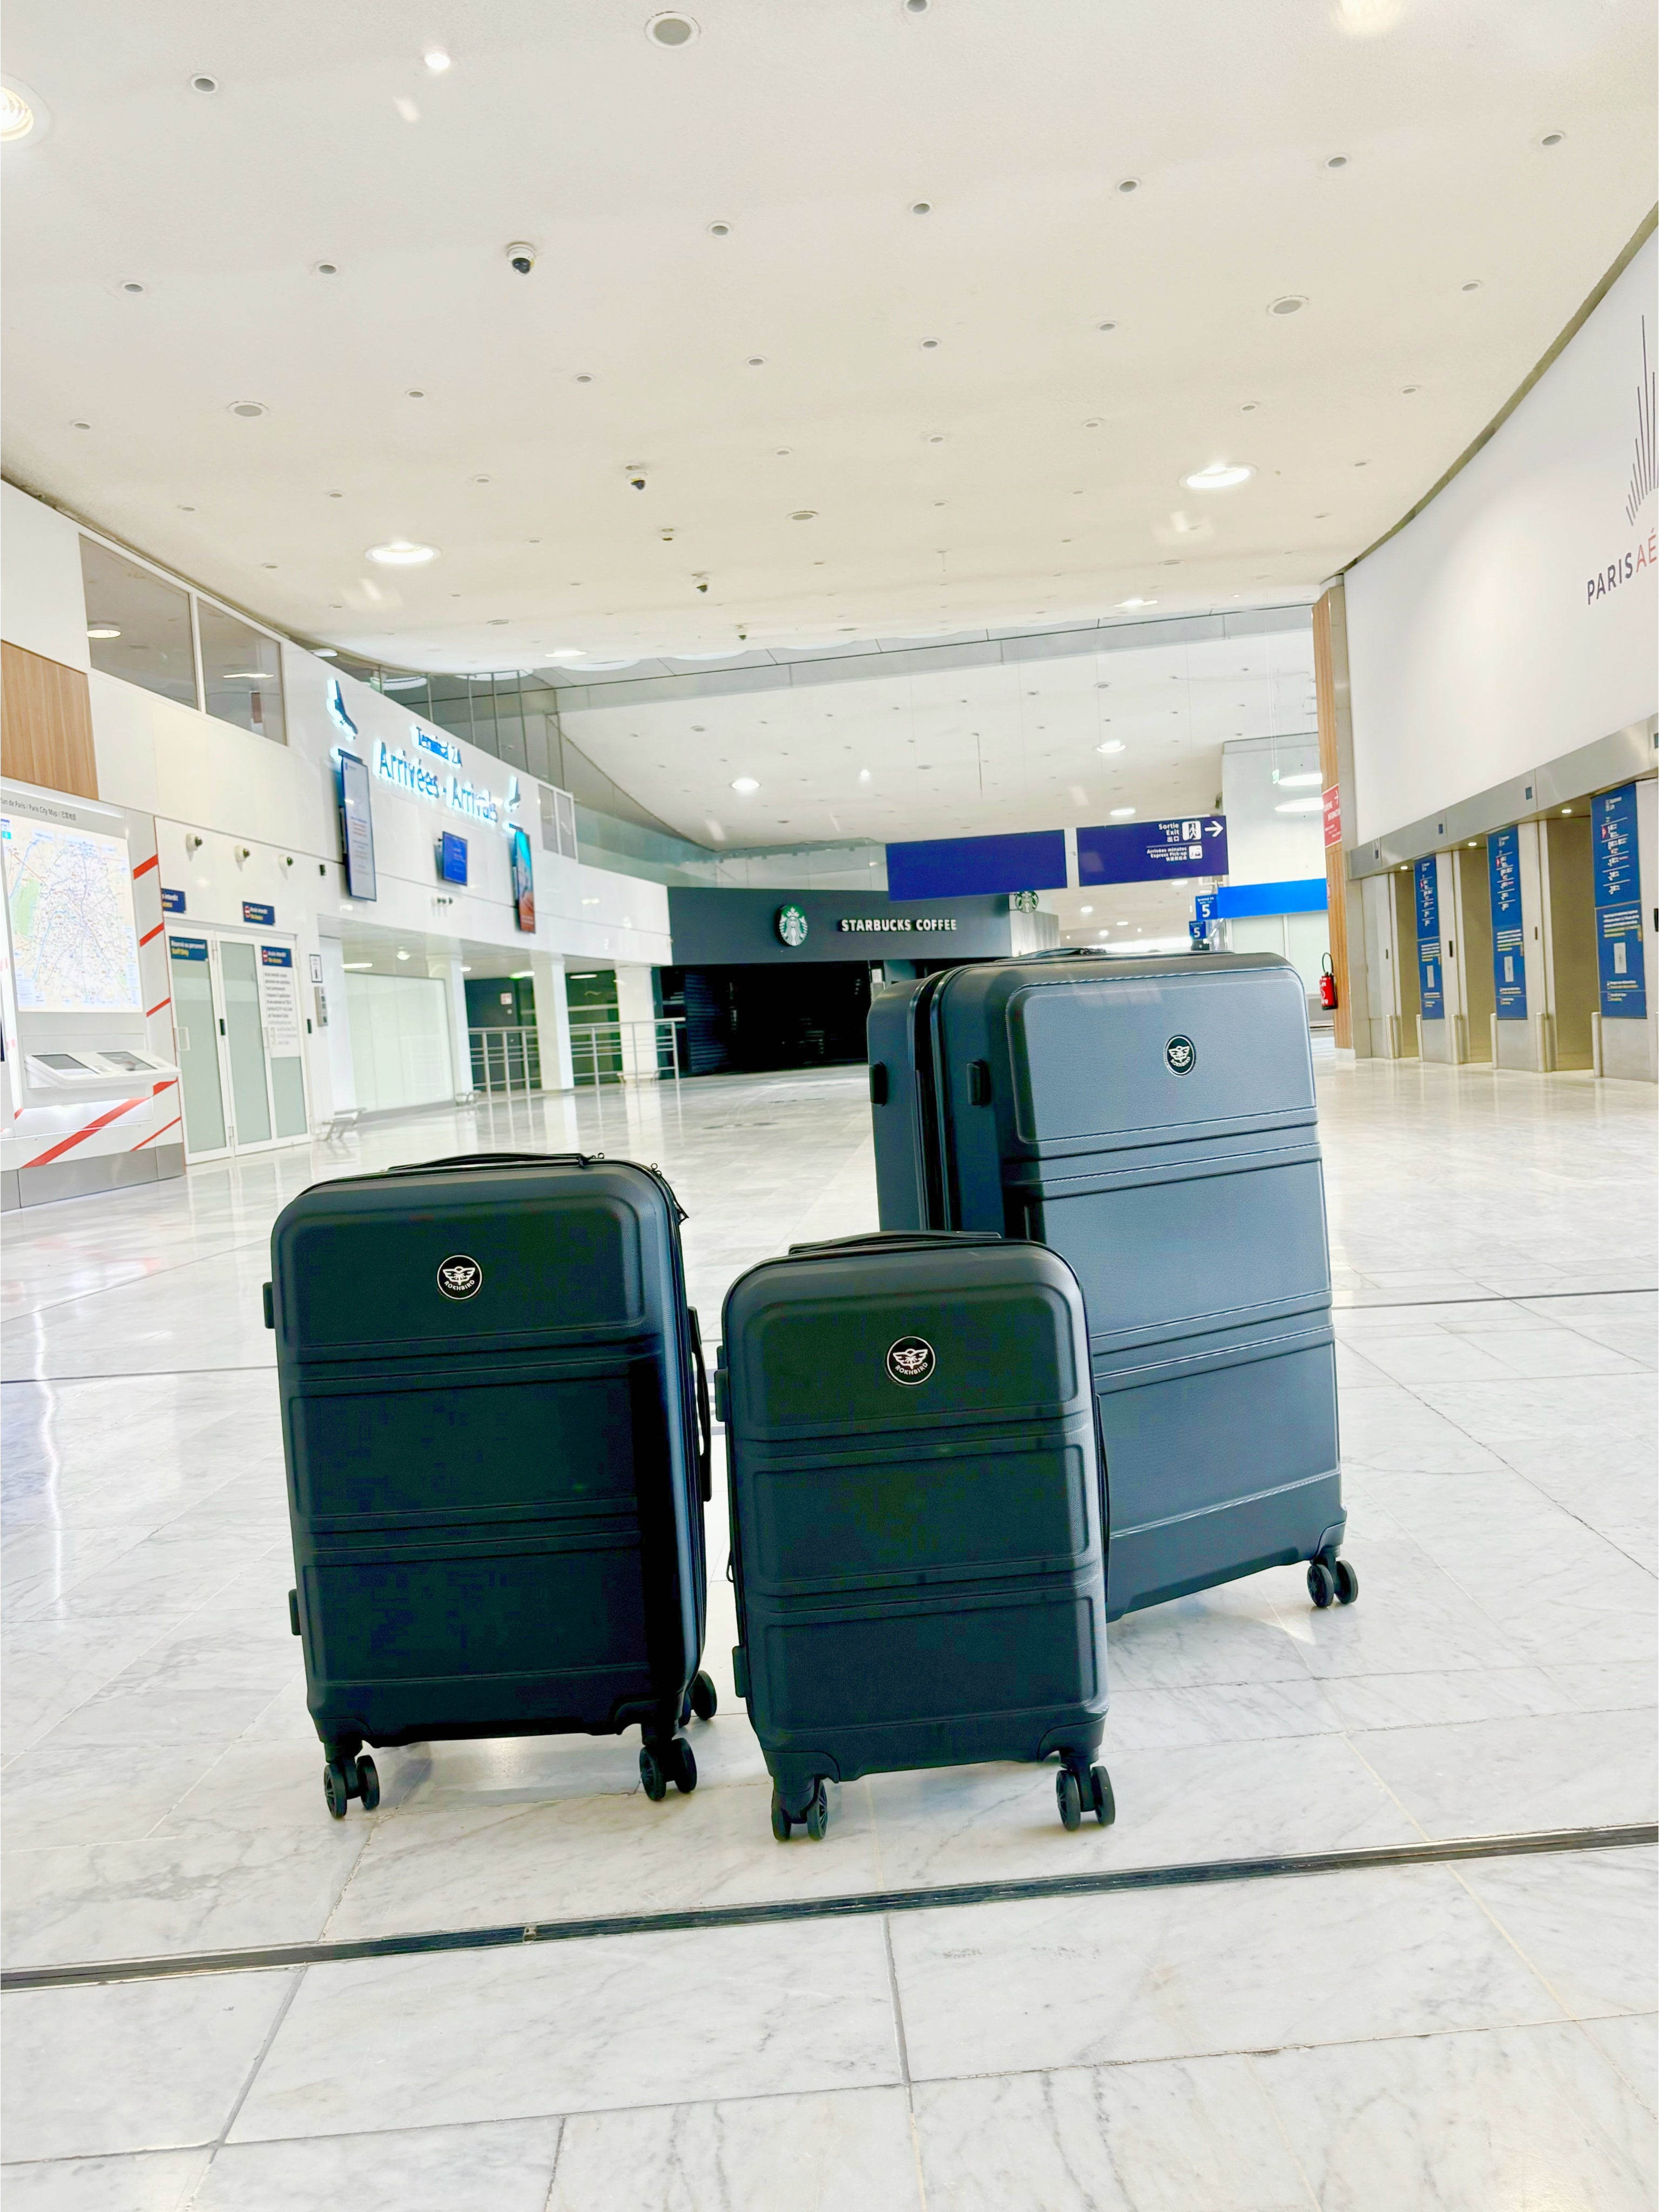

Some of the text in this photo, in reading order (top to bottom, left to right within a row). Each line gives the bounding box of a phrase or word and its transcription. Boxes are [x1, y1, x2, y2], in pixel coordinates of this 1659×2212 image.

[376, 740, 440, 799] Arrivées
[1202, 903, 1210, 918] 5
[841, 919, 957, 932] STARBUCKS COFFEE
[1193, 927, 1201, 938] 5
[444, 1279, 475, 1291] ROKHBIRD
[895, 1362, 928, 1375] ROKHBIRD
